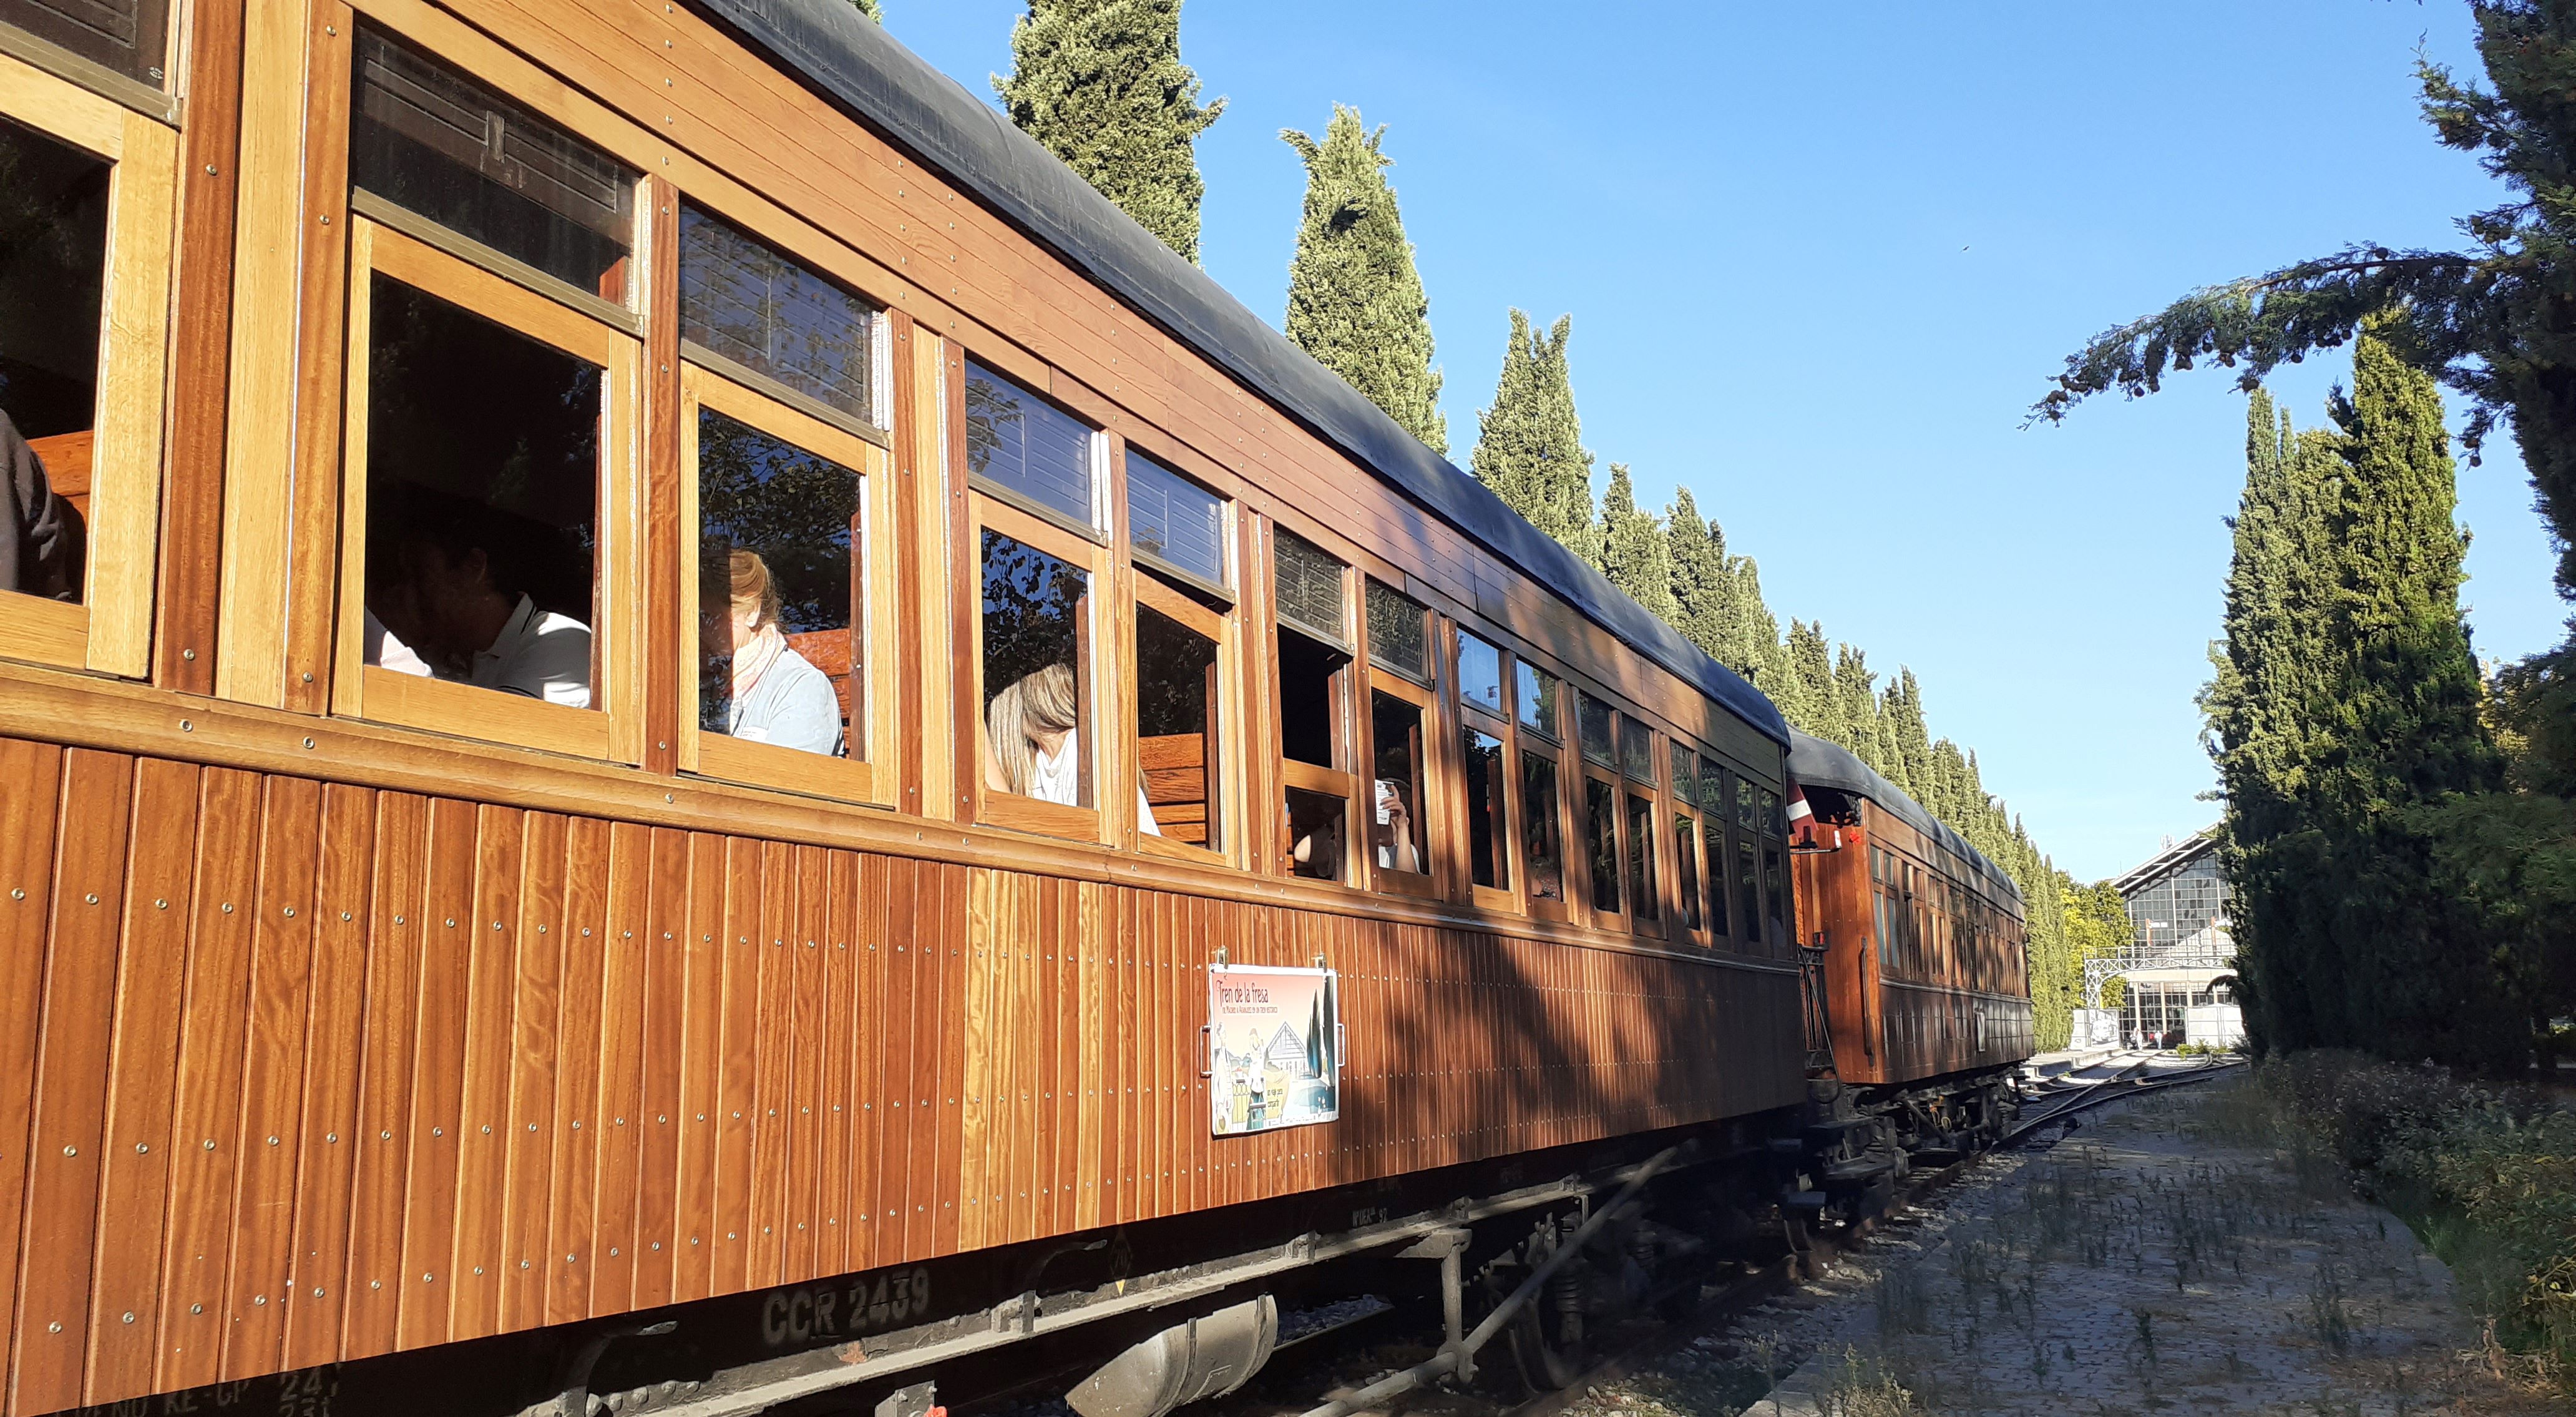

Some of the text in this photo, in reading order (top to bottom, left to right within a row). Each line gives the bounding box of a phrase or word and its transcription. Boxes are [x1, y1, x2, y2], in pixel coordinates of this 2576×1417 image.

[1216, 980, 1269, 1007] Tren de la fresa
[762, 1267, 930, 1344] CCR 2439
